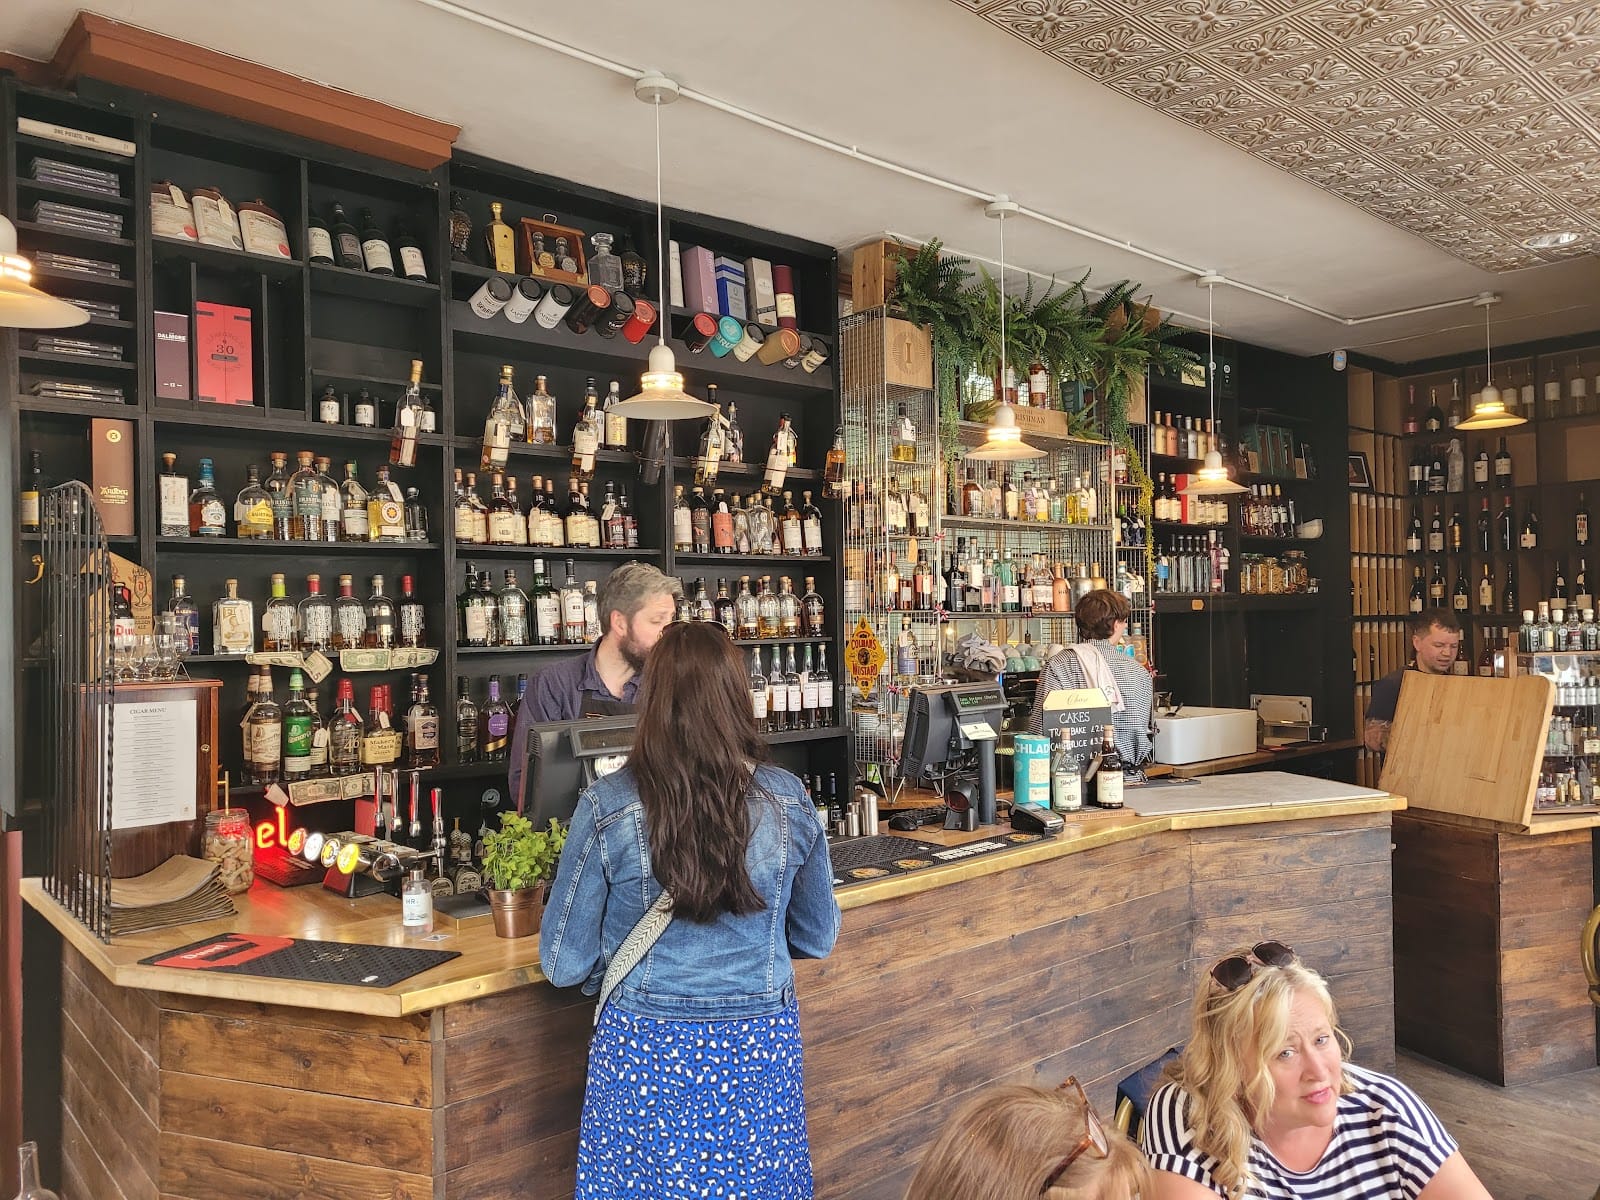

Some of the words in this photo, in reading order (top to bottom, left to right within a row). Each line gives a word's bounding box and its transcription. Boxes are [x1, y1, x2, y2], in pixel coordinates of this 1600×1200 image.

[157, 332, 187, 341] DALMORE
[216, 345, 235, 355] 30
[1015, 413, 1046, 425] RISHMAN
[1059, 711, 1091, 724] CAKES
[344, 735, 360, 752] 46
